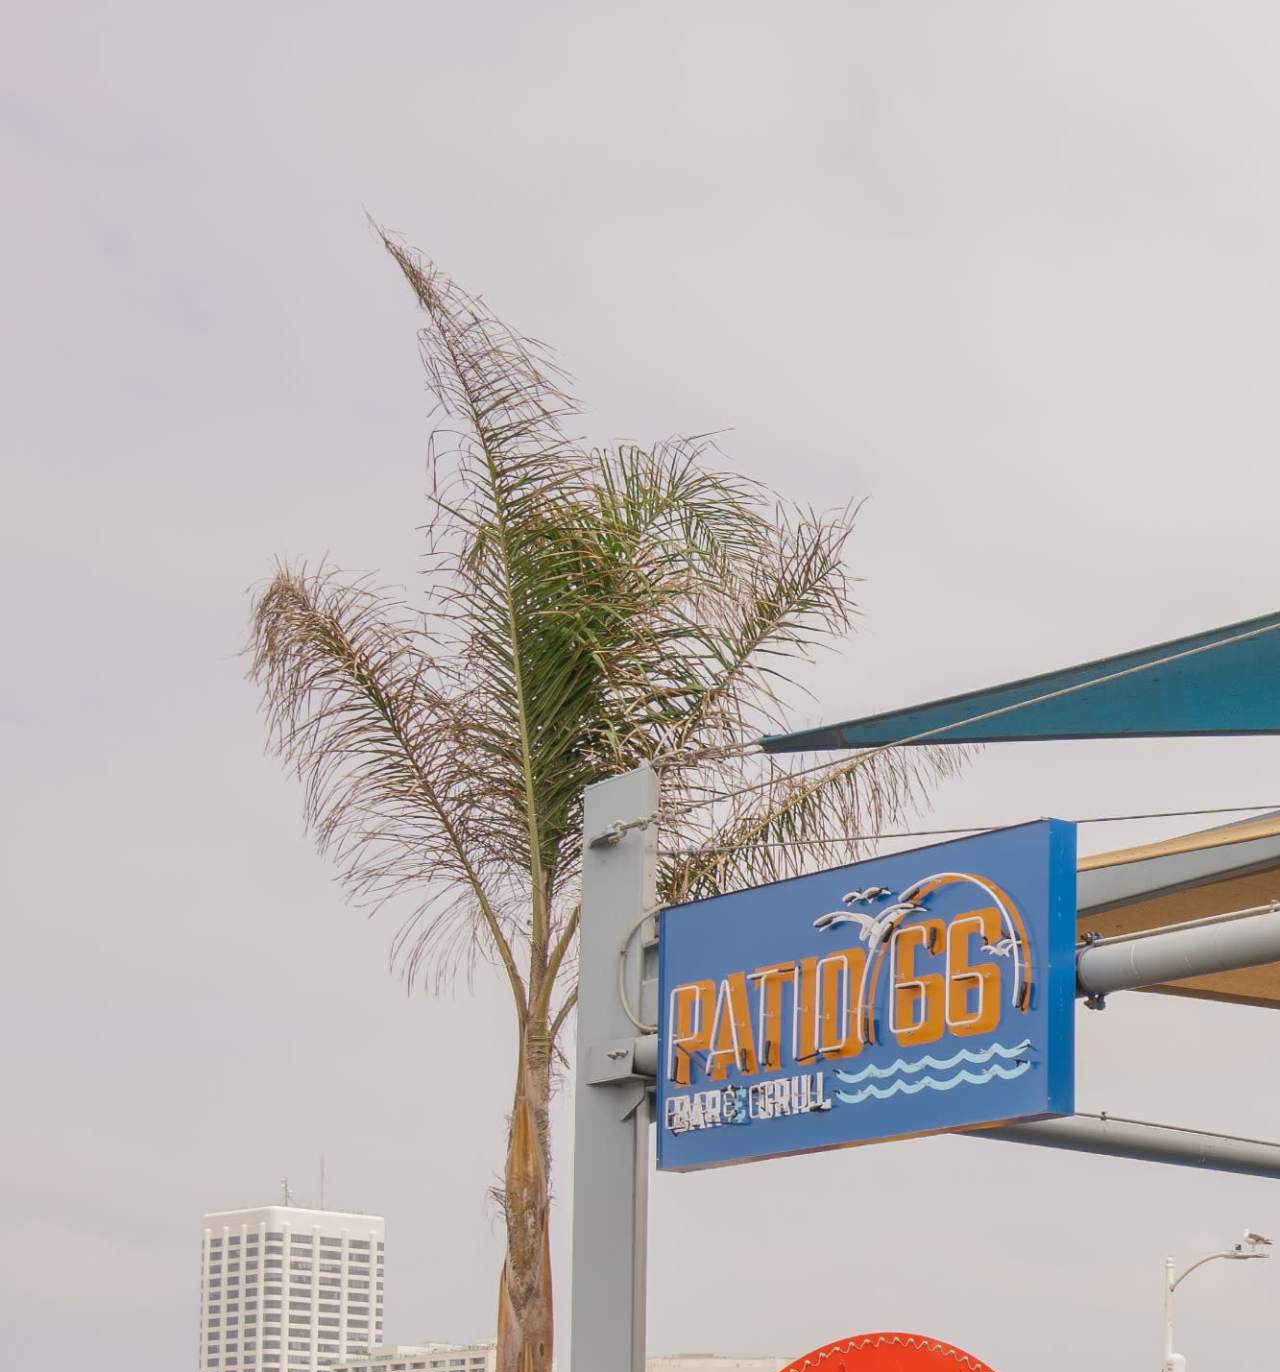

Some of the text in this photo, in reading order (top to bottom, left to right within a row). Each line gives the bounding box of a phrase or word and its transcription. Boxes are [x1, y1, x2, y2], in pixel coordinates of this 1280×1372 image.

[667, 907, 1001, 1085] PATIO 66
[665, 1090, 721, 1134] BAR
[749, 1072, 832, 1119] GRILL
